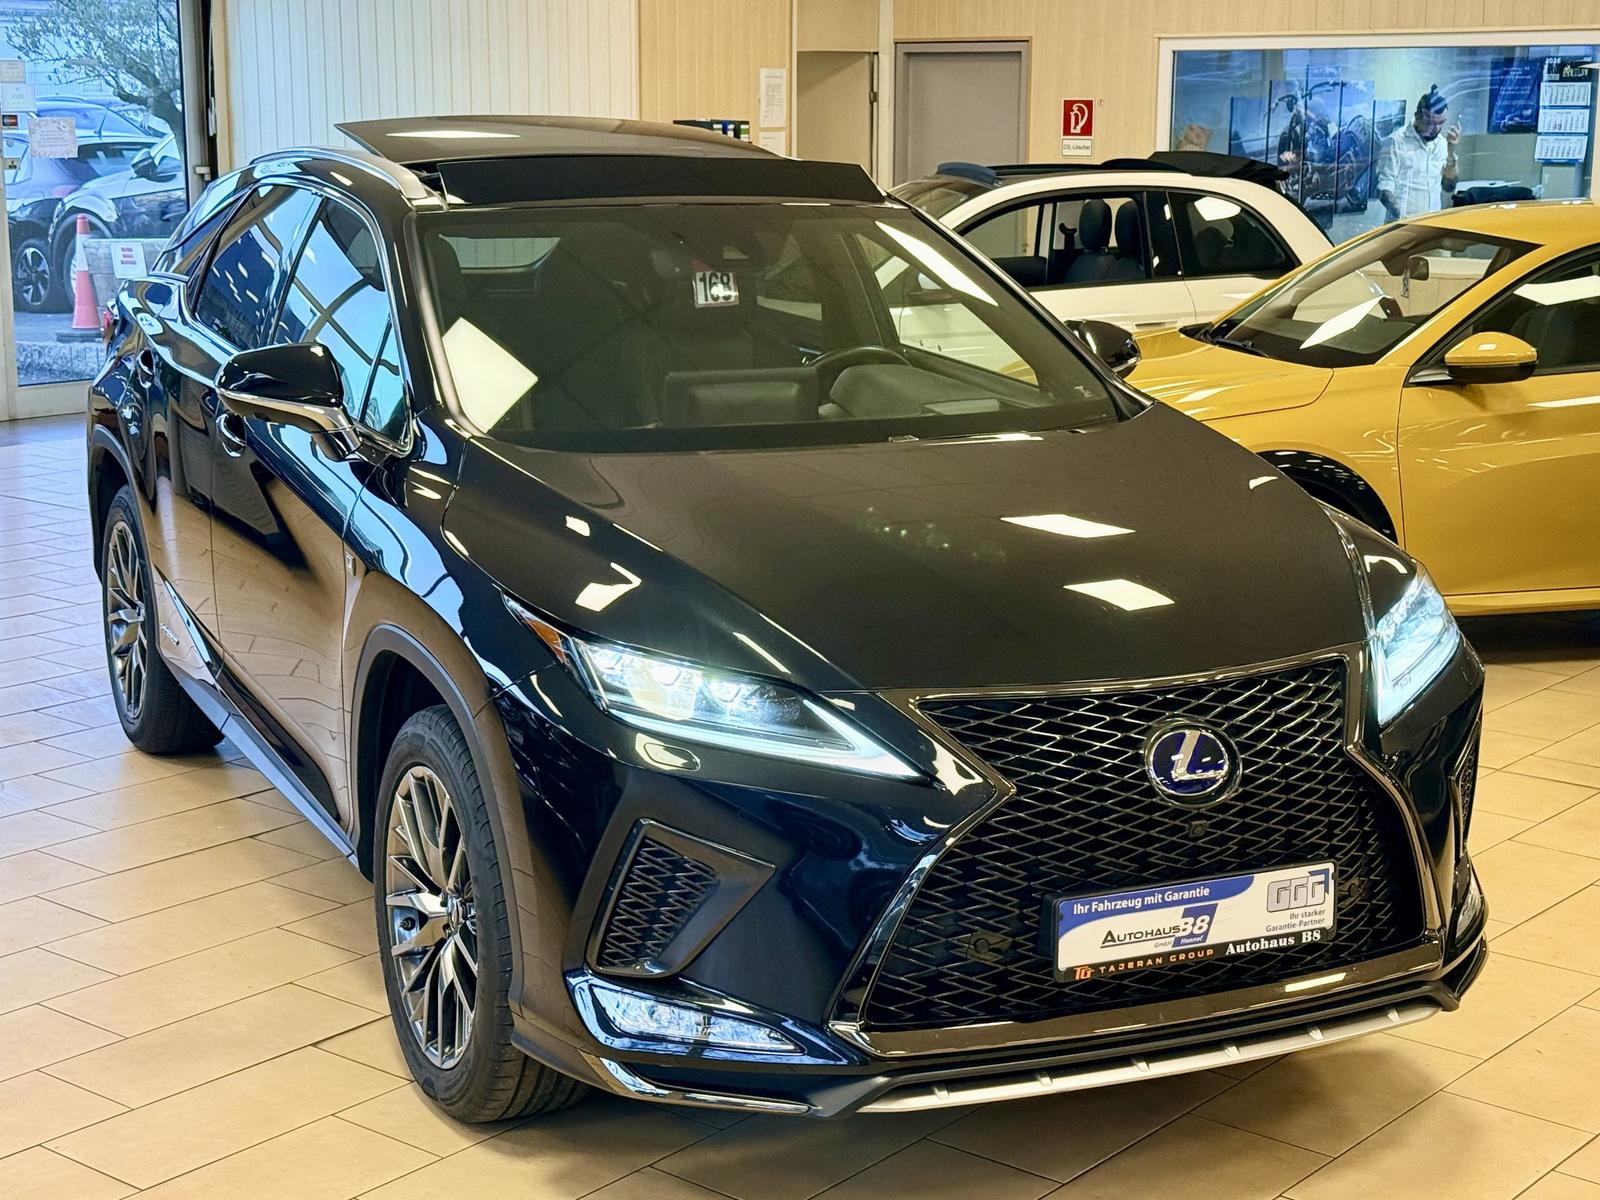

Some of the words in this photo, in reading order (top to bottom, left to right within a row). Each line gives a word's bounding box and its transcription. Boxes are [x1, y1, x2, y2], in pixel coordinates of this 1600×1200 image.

[1073, 903, 1089, 915] Ihr
[1091, 897, 1142, 913] Fahrzeug
[1144, 893, 1163, 905] mit
[1164, 886, 1210, 902] Garantie
[1289, 912, 1299, 920] Ihr
[1300, 909, 1326, 918] starker
[1265, 918, 1325, 933] Garantie-Partner
[1225, 936, 1295, 956] Autohaus
[1301, 929, 1321, 943] B8
[1169, 948, 1214, 962] GROUP
